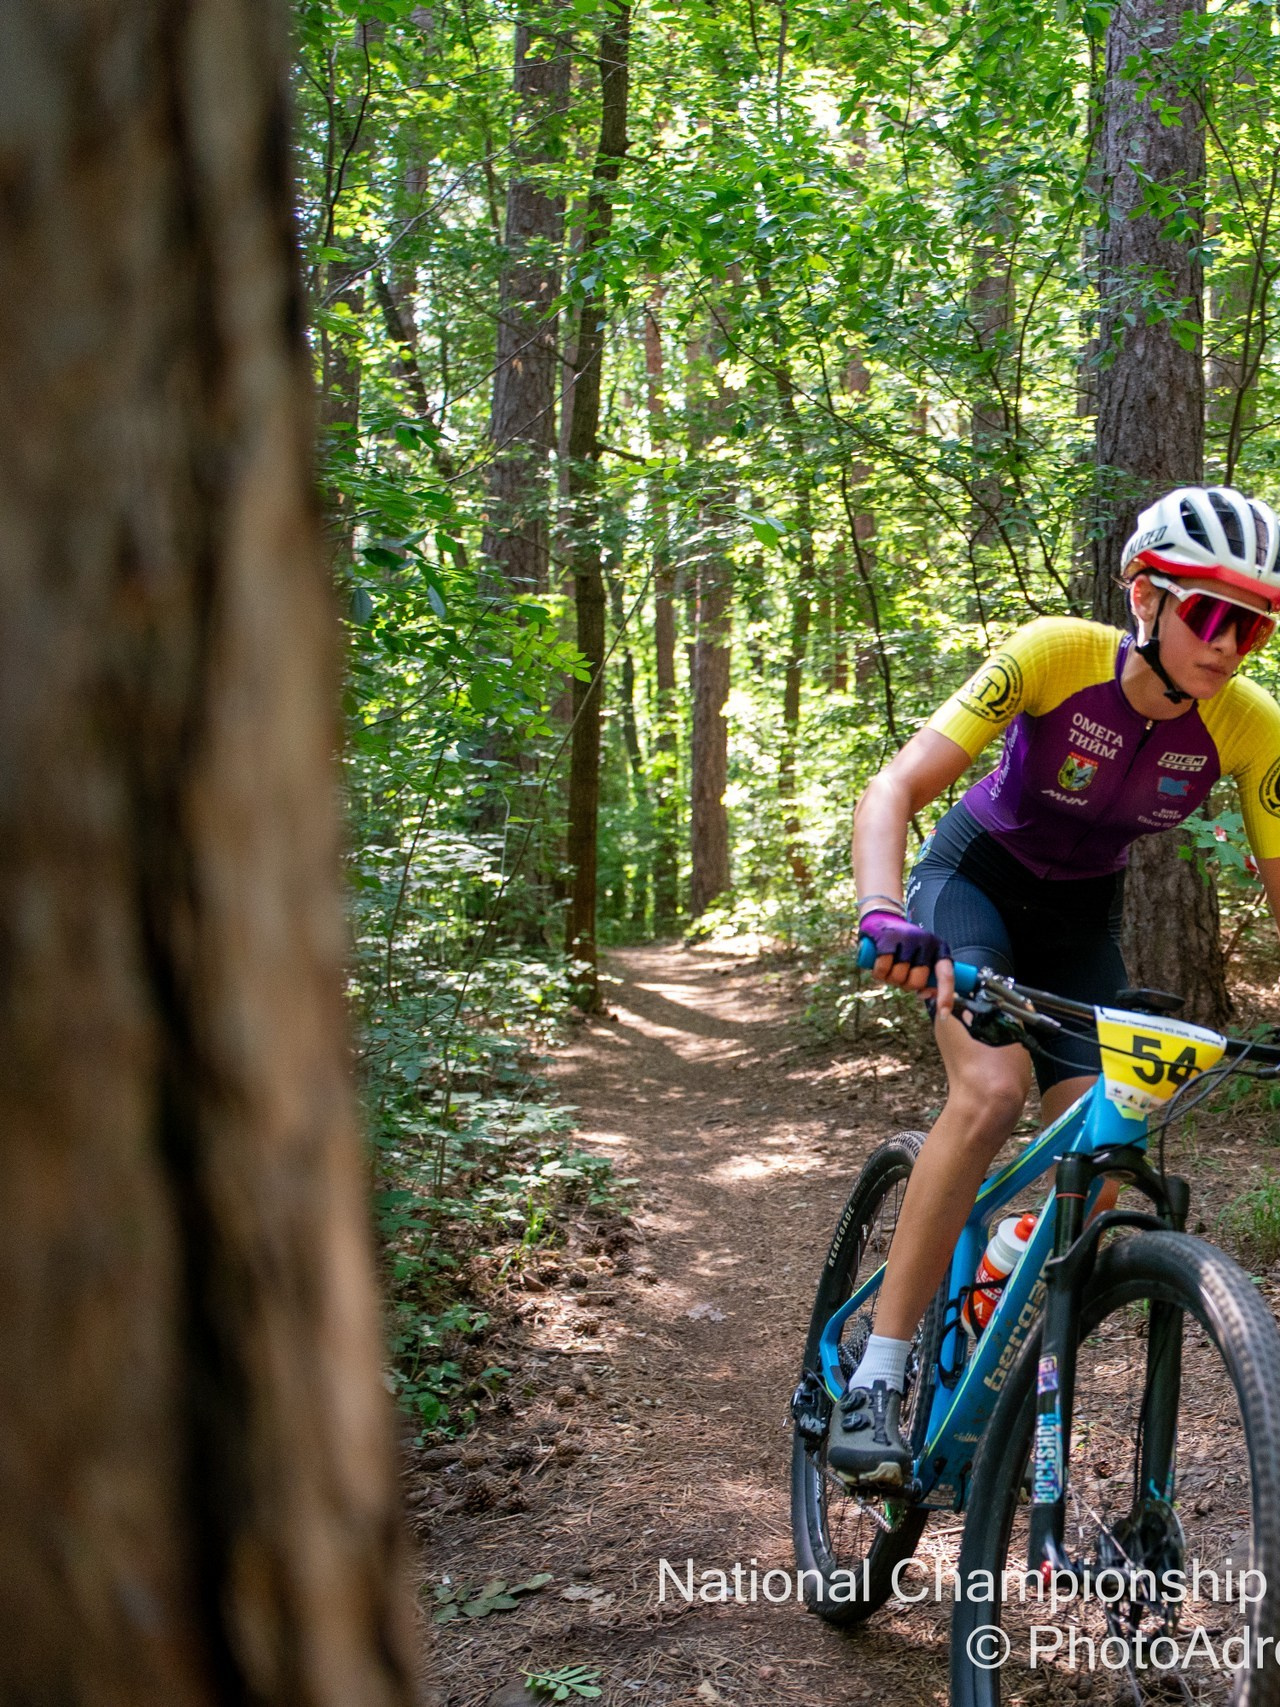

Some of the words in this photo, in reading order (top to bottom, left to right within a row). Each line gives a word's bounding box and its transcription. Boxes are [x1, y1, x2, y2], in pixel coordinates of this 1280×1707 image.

[1068, 728, 1118, 760] ТИЙМ
[1072, 712, 1123, 748] ОМЕГА
[1163, 753, 1205, 766] DIEM
[1132, 1034, 1197, 1090] 54
